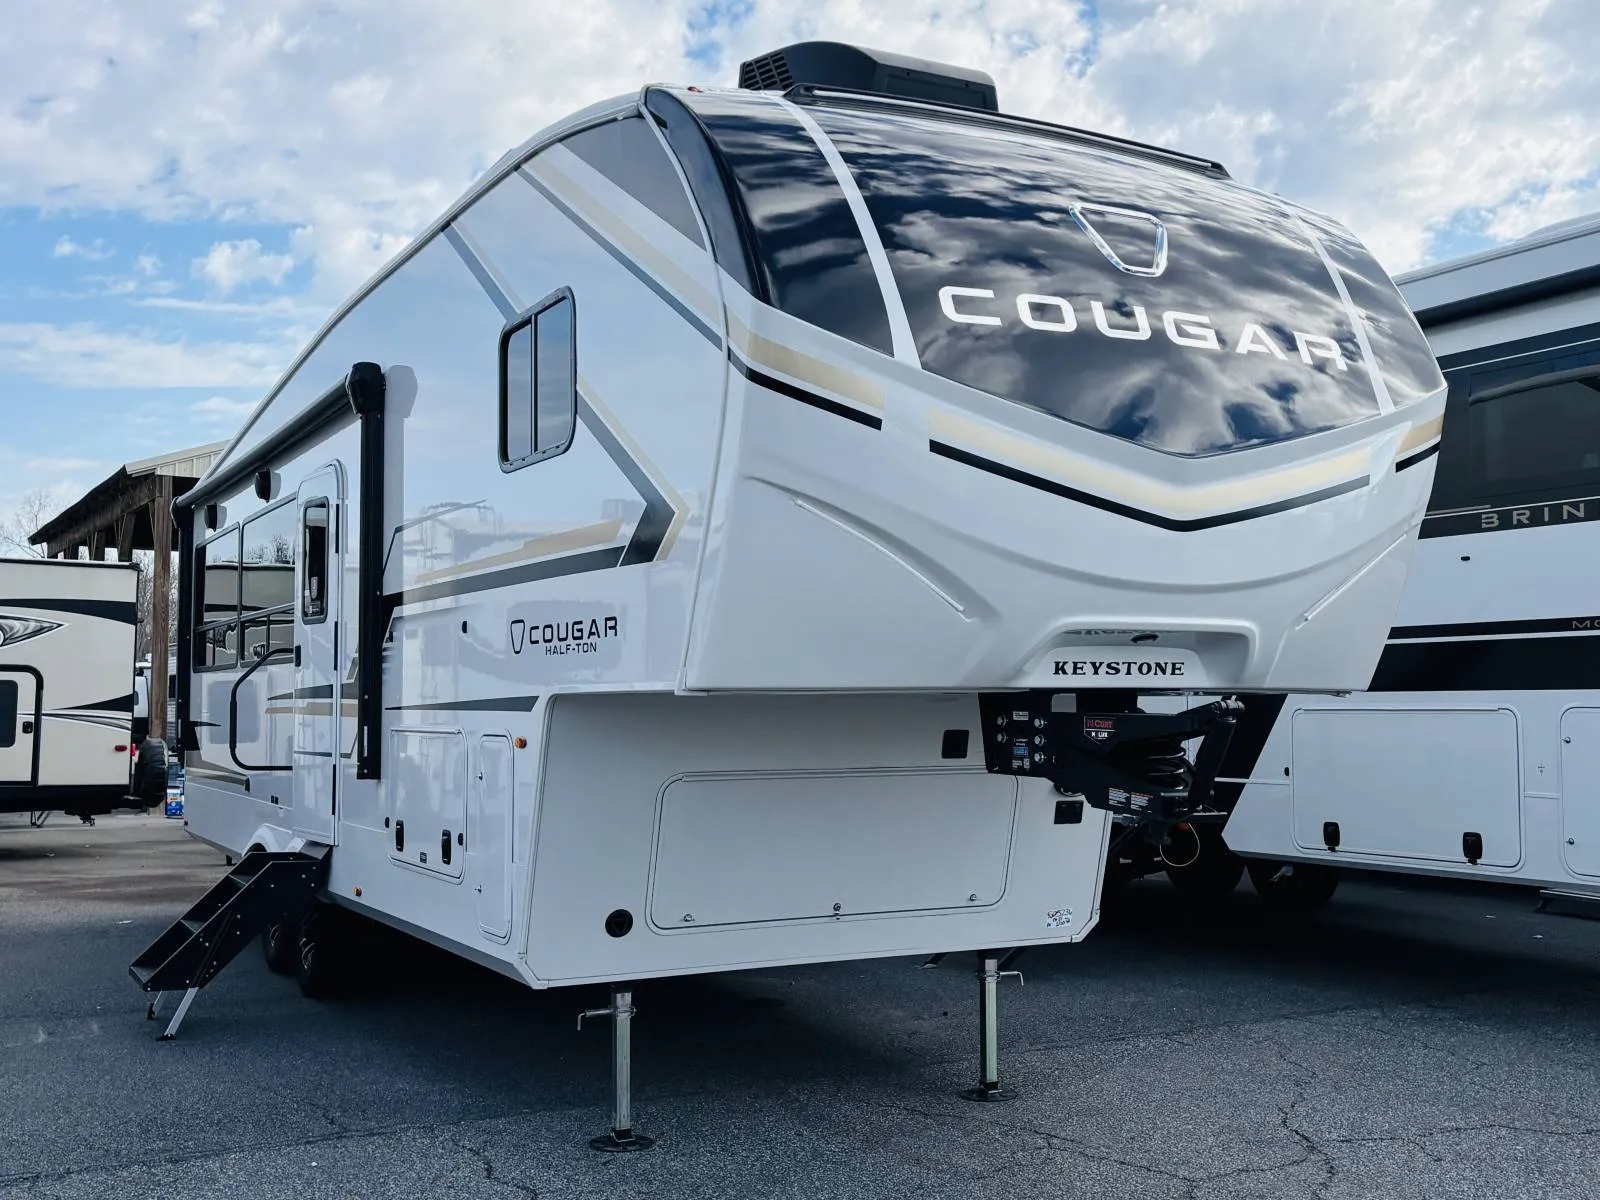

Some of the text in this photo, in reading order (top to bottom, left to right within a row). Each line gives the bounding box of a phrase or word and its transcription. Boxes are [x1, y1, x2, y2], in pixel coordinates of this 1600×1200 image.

[938, 285, 1348, 371] COUGAR
[1481, 503, 1585, 529] BRIN
[529, 616, 618, 645] COUGAR
[545, 641, 597, 656] HALF-TON
[1052, 661, 1185, 676] KEYSTONE
